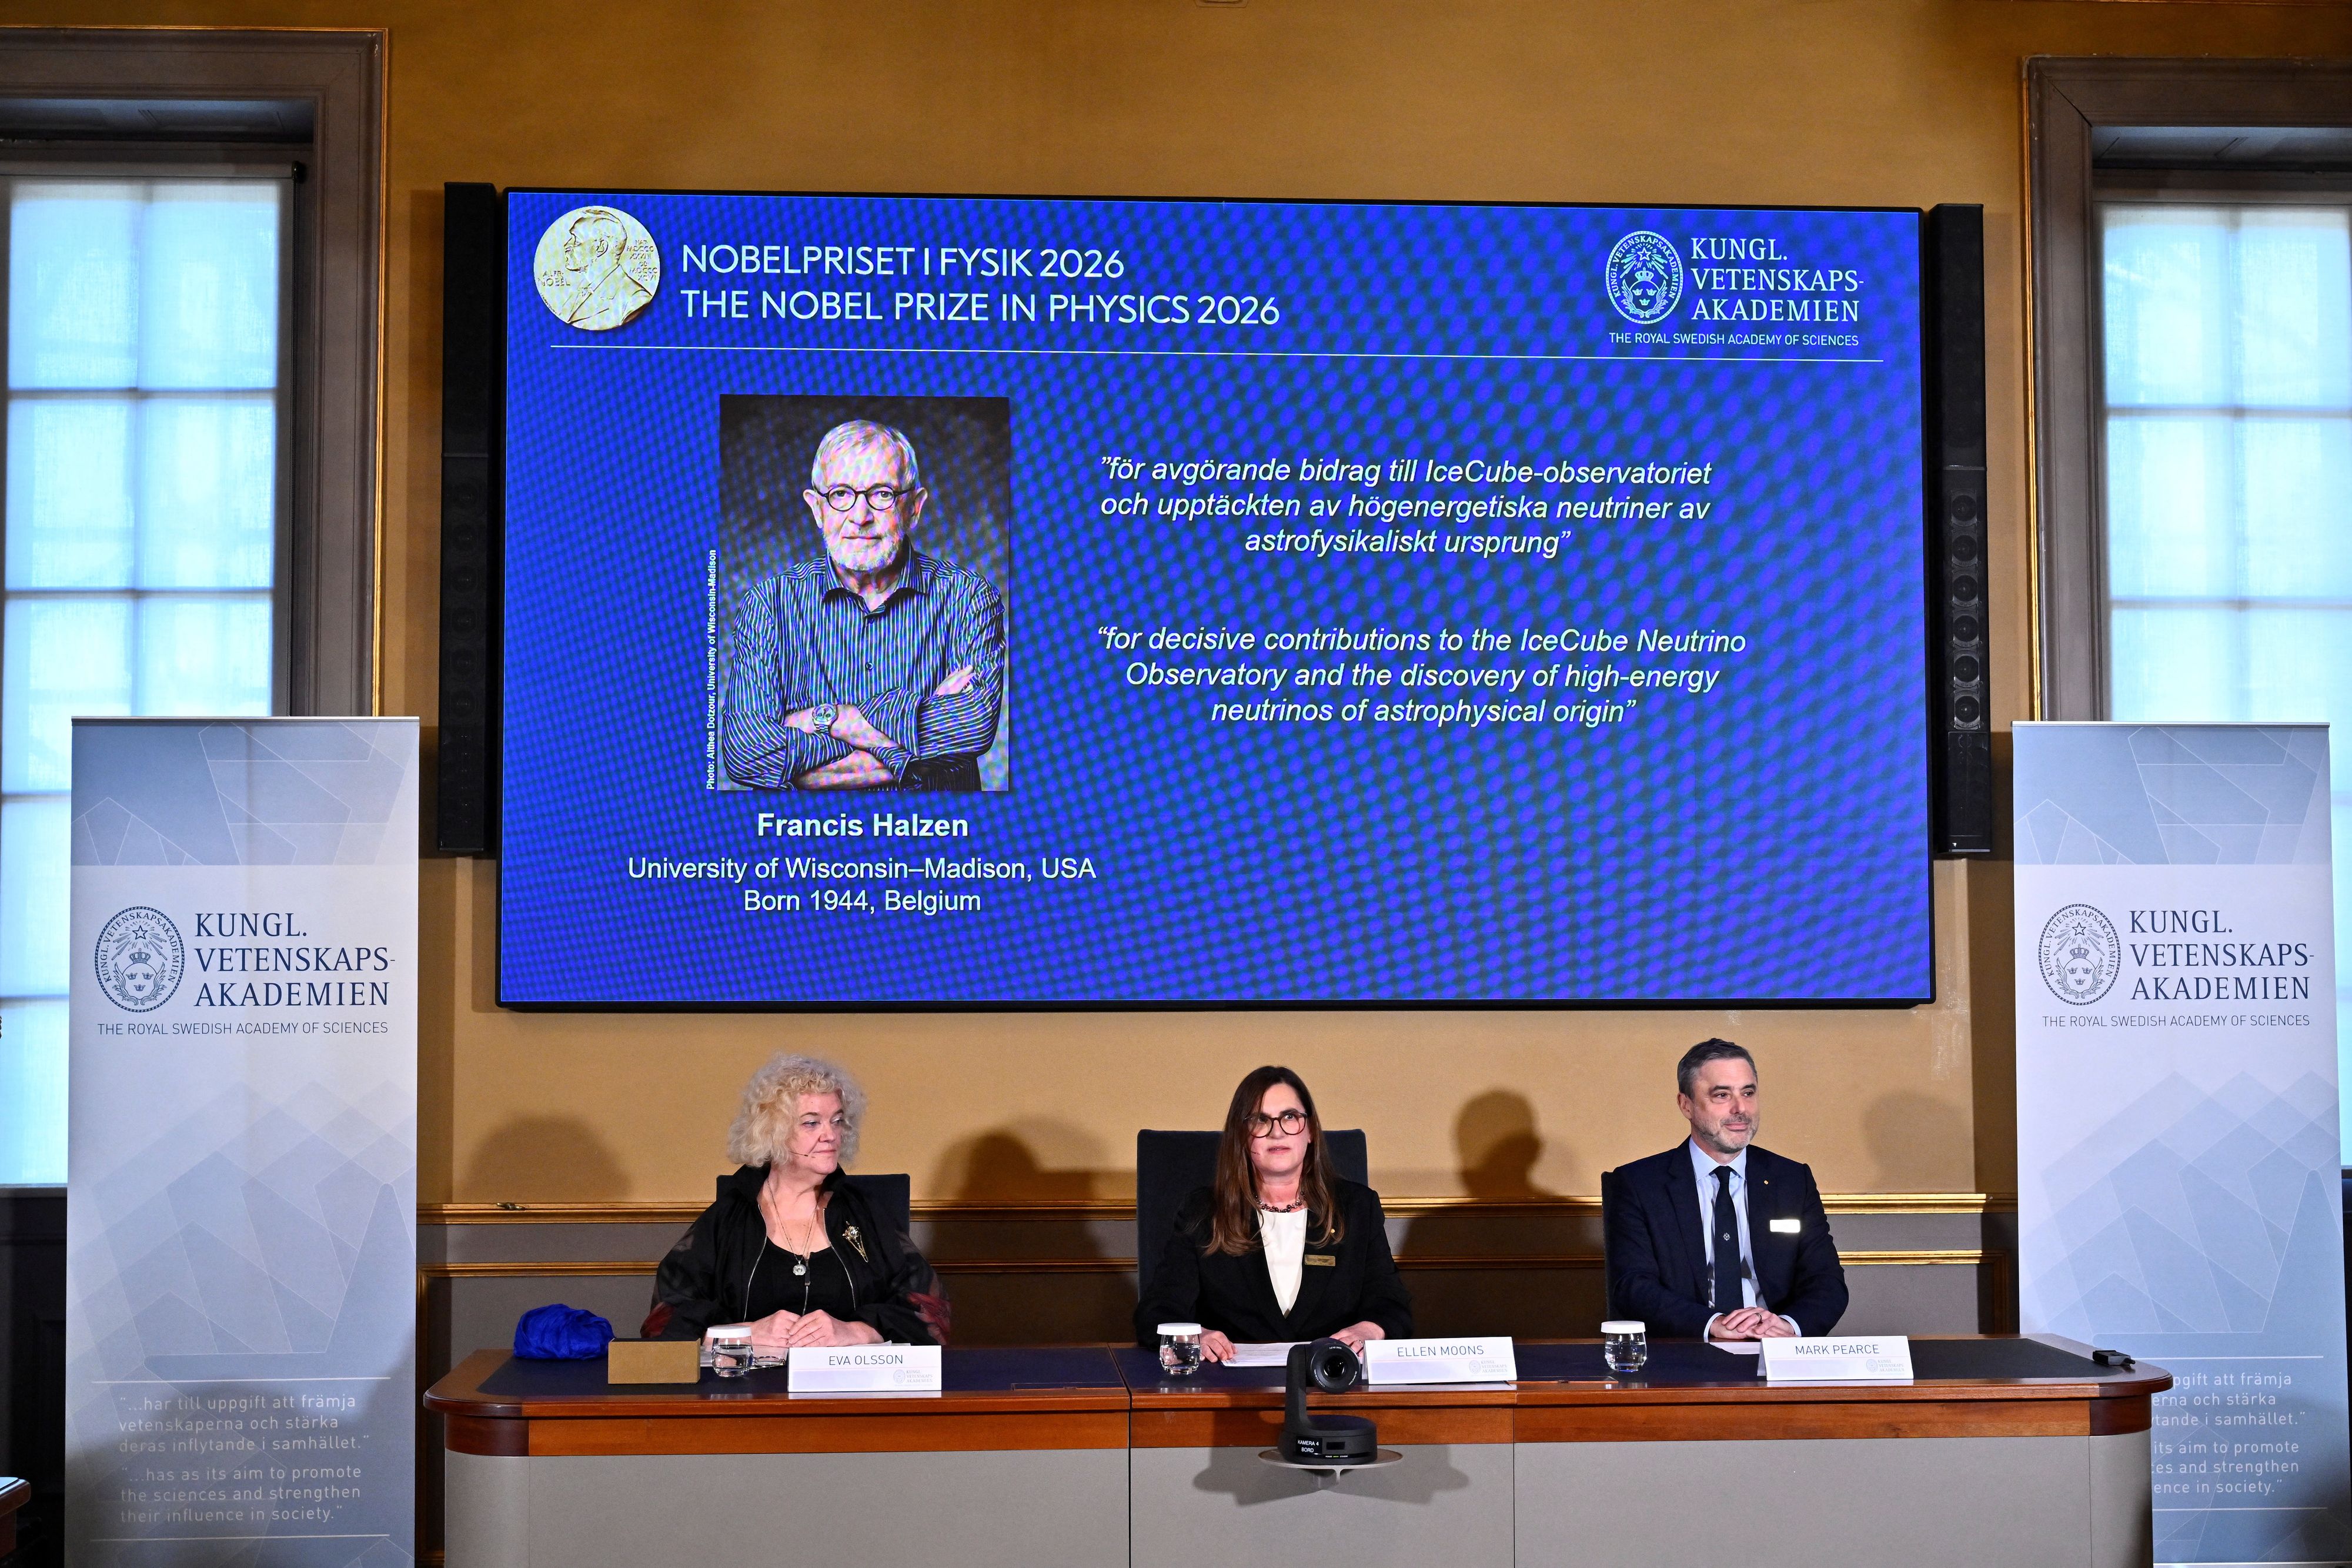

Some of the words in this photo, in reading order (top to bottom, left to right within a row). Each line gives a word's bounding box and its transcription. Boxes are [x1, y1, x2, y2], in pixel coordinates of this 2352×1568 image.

[1691, 238, 1787, 260] KUNGL.
[683, 245, 915, 275] NOBELPRISET
[924, 248, 929, 275] I
[941, 248, 1033, 276] FYSIK
[1040, 249, 1124, 278] 2026
[1613, 236, 1679, 299] VETENSKAPSAKADEMIEN
[537, 278, 570, 286] NOBEL
[1611, 264, 1621, 297] KUNGL.
[1690, 268, 1863, 291] VETENSKAPS-
[681, 290, 748, 317] THE
[763, 291, 883, 319] NOBEL
[896, 293, 988, 320] PRIZE
[1003, 294, 1035, 321] IN
[1050, 295, 1189, 323] PHYSICS
[1198, 296, 1279, 325] 2026
[1692, 299, 1859, 321] AKADEMIEN
[1609, 333, 1631, 343] THE
[1635, 333, 1670, 343] ROYAL
[1673, 333, 1724, 344] SWEDISH
[1728, 334, 1782, 345] ACADEMY
[1785, 335, 1799, 345] OF
[1802, 335, 1859, 346] SCIENCES
[1152, 458, 1290, 485] avgörande
[1299, 459, 1381, 487] bidrag
[1389, 459, 1418, 482] till
[1426, 460, 1712, 484] IceCube-observatoriet
[1101, 493, 1148, 514] och
[1158, 493, 1300, 520] upptäckten
[1310, 500, 1341, 516] av
[1349, 494, 1547, 523] högenergetiska
[1556, 496, 1673, 519] neutriner
[1679, 503, 1710, 519] av
[1245, 529, 1437, 557] astrofysikaliskt
[707, 550, 716, 633] Wisconsin-Madison
[707, 636, 715, 644] of
[1149, 627, 1255, 649] decisive
[1265, 628, 1431, 650] contributions
[1440, 628, 1462, 650] to
[1472, 628, 1511, 650] the
[1521, 628, 1628, 651] IceCube
[1637, 630, 1745, 651] Neutrino
[707, 647, 717, 690] University
[1127, 663, 1287, 691] Observatory
[1295, 663, 1344, 685] and
[1352, 663, 1392, 686] the
[1401, 664, 1525, 692] discovery
[1533, 664, 1560, 686] of
[1565, 664, 1719, 693] high-energy
[707, 693, 716, 728] Dotzour,
[1212, 698, 1333, 721] neutrinos
[1342, 699, 1369, 721] of
[1374, 699, 1546, 727] astrophysical
[759, 813, 863, 835] Francis
[874, 814, 967, 836] Halzen
[629, 858, 747, 883] University
[755, 858, 779, 878] of
[786, 858, 1031, 882] Wisconsin–Madison,
[1043, 858, 1096, 878] USA
[745, 890, 799, 910] Born
[811, 890, 874, 914] 1944,
[886, 890, 980, 915] Belgium
[195, 913, 306, 937] KUNGL.
[2130, 911, 2232, 932] KUNGL.
[103, 912, 179, 982] VETENSKAPSAKADEMIEN
[2046, 910, 2116, 977] VETENSKAPSAKADEMIEN
[101, 945, 112, 982] KUNGL.
[194, 948, 395, 972] VETENSKAPS-
[2043, 941, 2054, 977] KUNGL.
[2130, 944, 2314, 967] VETENSKAPS-
[193, 982, 389, 1006] AKADEMIEN
[2131, 977, 2310, 999] AKADEMIEN
[98, 1024, 123, 1035] THE
[128, 1024, 168, 1034] ROYAL
[173, 1023, 231, 1034] SWEDISH
[236, 1023, 298, 1034] ACADEMY
[303, 1022, 319, 1033] OF
[323, 1022, 387, 1033] SCIENCES
[2043, 1017, 2065, 1027] THE
[2070, 1017, 2107, 1027] ROYAL
[2112, 1016, 2166, 1027] SWEDISH
[2170, 1015, 2227, 1026] ACADEMY
[2231, 1015, 2246, 1025] OF
[2251, 1015, 2309, 1025] SCIENCES
[830, 1356, 850, 1365] EVA
[855, 1355, 902, 1365] OLSSON
[1398, 1347, 1435, 1356] ELLEN
[1441, 1346, 1484, 1355] MOONS
[1796, 1346, 1829, 1354] MARK
[1833, 1345, 1879, 1354] PEARCE
[2173, 1373, 2208, 1389] pgift
[2214, 1373, 2234, 1386] att
[2241, 1372, 2291, 1388] främja
[178, 1396, 201, 1410] till
[208, 1396, 266, 1413] uppgift
[273, 1395, 294, 1409] att
[302, 1394, 355, 1412] främja
[2194, 1393, 2220, 1406] och
[2227, 1392, 2276, 1405] stärka
[119, 1418, 243, 1433] vetenskaperna
[250, 1417, 278, 1429] och
[286, 1416, 338, 1429] stärka
[2205, 1413, 2208, 1425] i
[119, 1438, 166, 1452] deras
[173, 1437, 255, 1453] inflytande
[262, 1437, 265, 1450] i
[2154, 1442, 2172, 1453] its
[2179, 1442, 2207, 1453] aim
[2214, 1442, 2227, 1453] to
[2234, 1441, 2298, 1456] promote
[181, 1470, 199, 1481] as
[206, 1467, 226, 1480] its
[233, 1467, 263, 1480] aim
[270, 1467, 285, 1479] to
[292, 1466, 361, 1482] promote
[2179, 1460, 2206, 1473] and
[2213, 1460, 2298, 1476] strengthen
[122, 1488, 146, 1502] the
[154, 1487, 226, 1501] sciences
[233, 1487, 262, 1500] and
[269, 1485, 360, 1502] strengthen
[2197, 1480, 2210, 1493] in
[121, 1509, 161, 1523] their
[167, 1507, 243, 1522] influence
[250, 1508, 265, 1520] in
